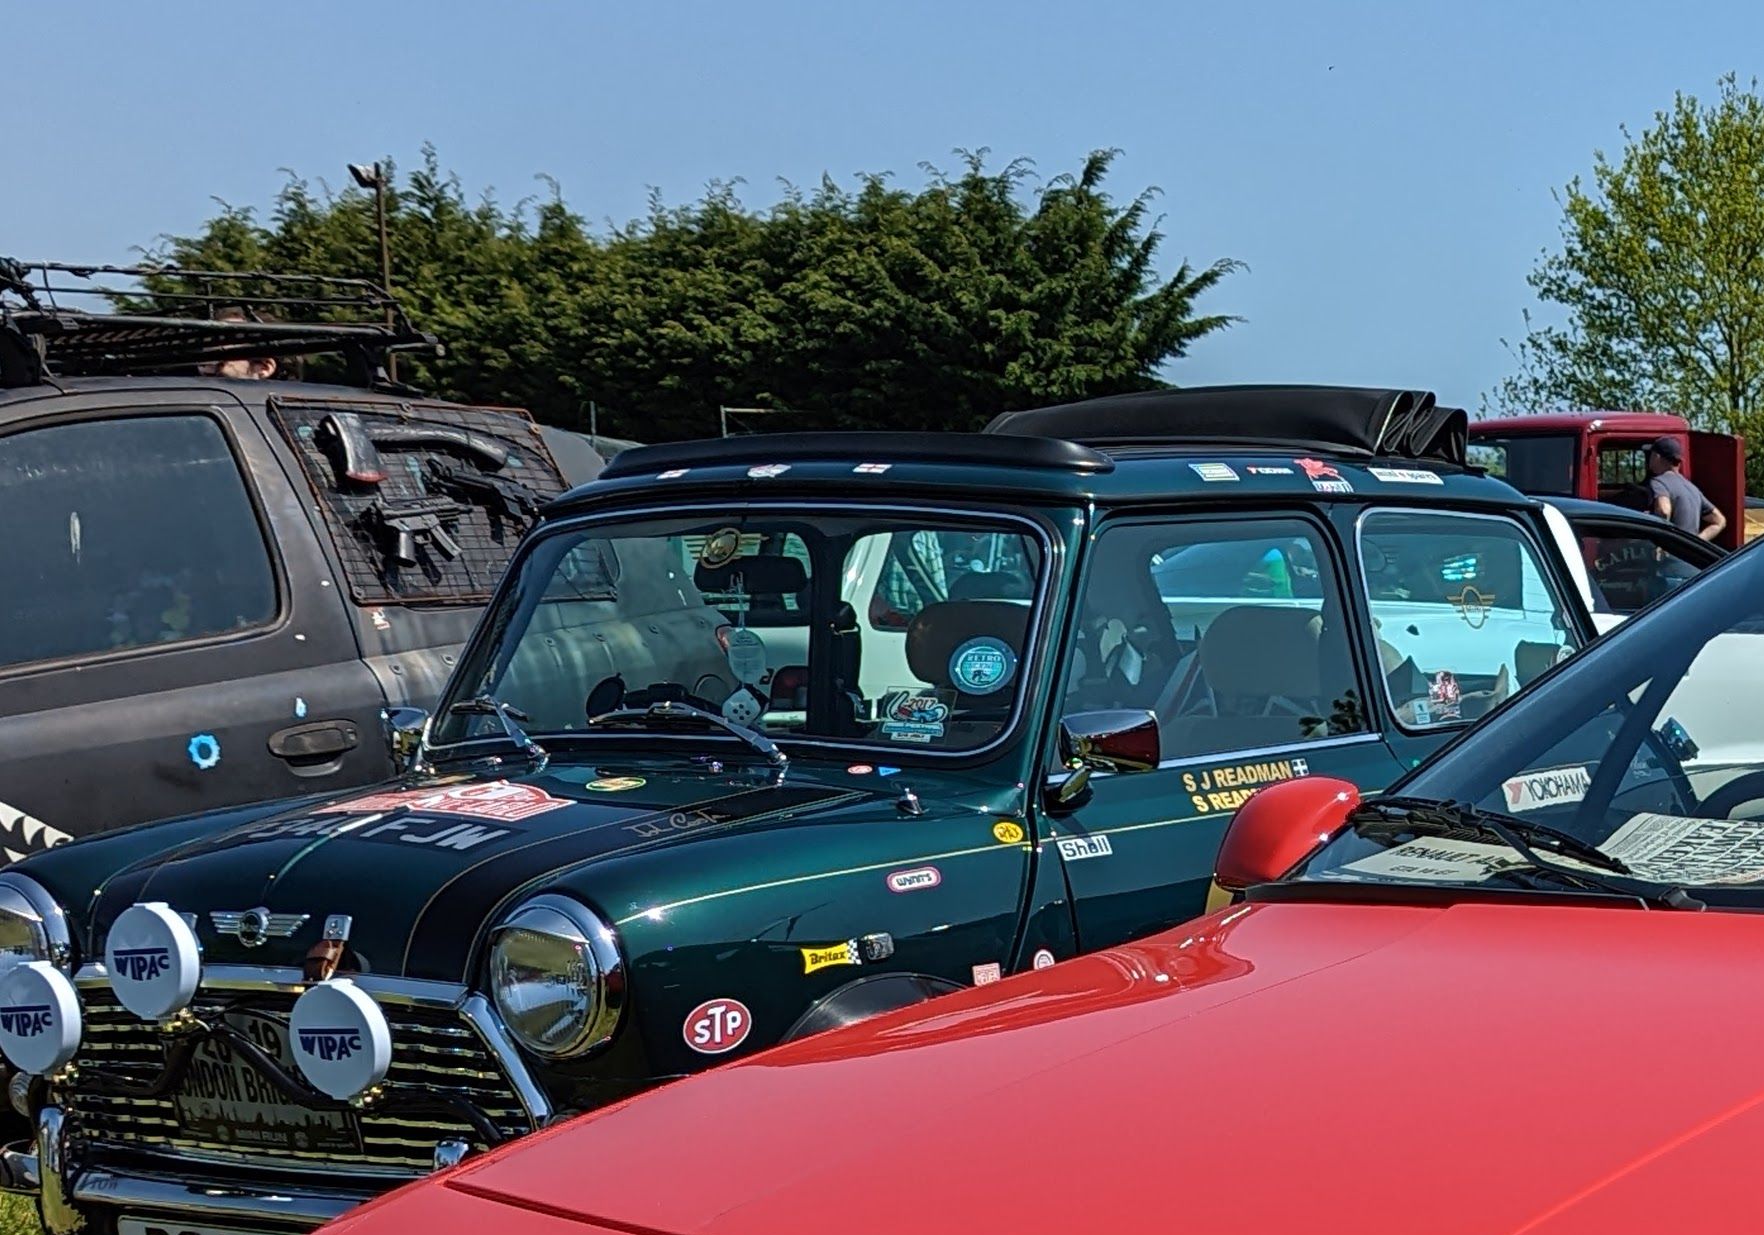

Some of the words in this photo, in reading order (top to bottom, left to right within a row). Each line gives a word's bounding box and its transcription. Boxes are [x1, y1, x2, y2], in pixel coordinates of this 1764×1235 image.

[1183, 773, 1197, 792] S
[1200, 771, 1212, 791] J
[1213, 761, 1294, 788] READMAN
[1192, 795, 1210, 813] S
[1062, 837, 1112, 859] Shell
[113, 954, 170, 982] WIPAC
[810, 949, 847, 965] Britax
[1, 1011, 53, 1037] WIPAC
[694, 1005, 742, 1044] STP
[299, 1034, 362, 1061] WIPAC
